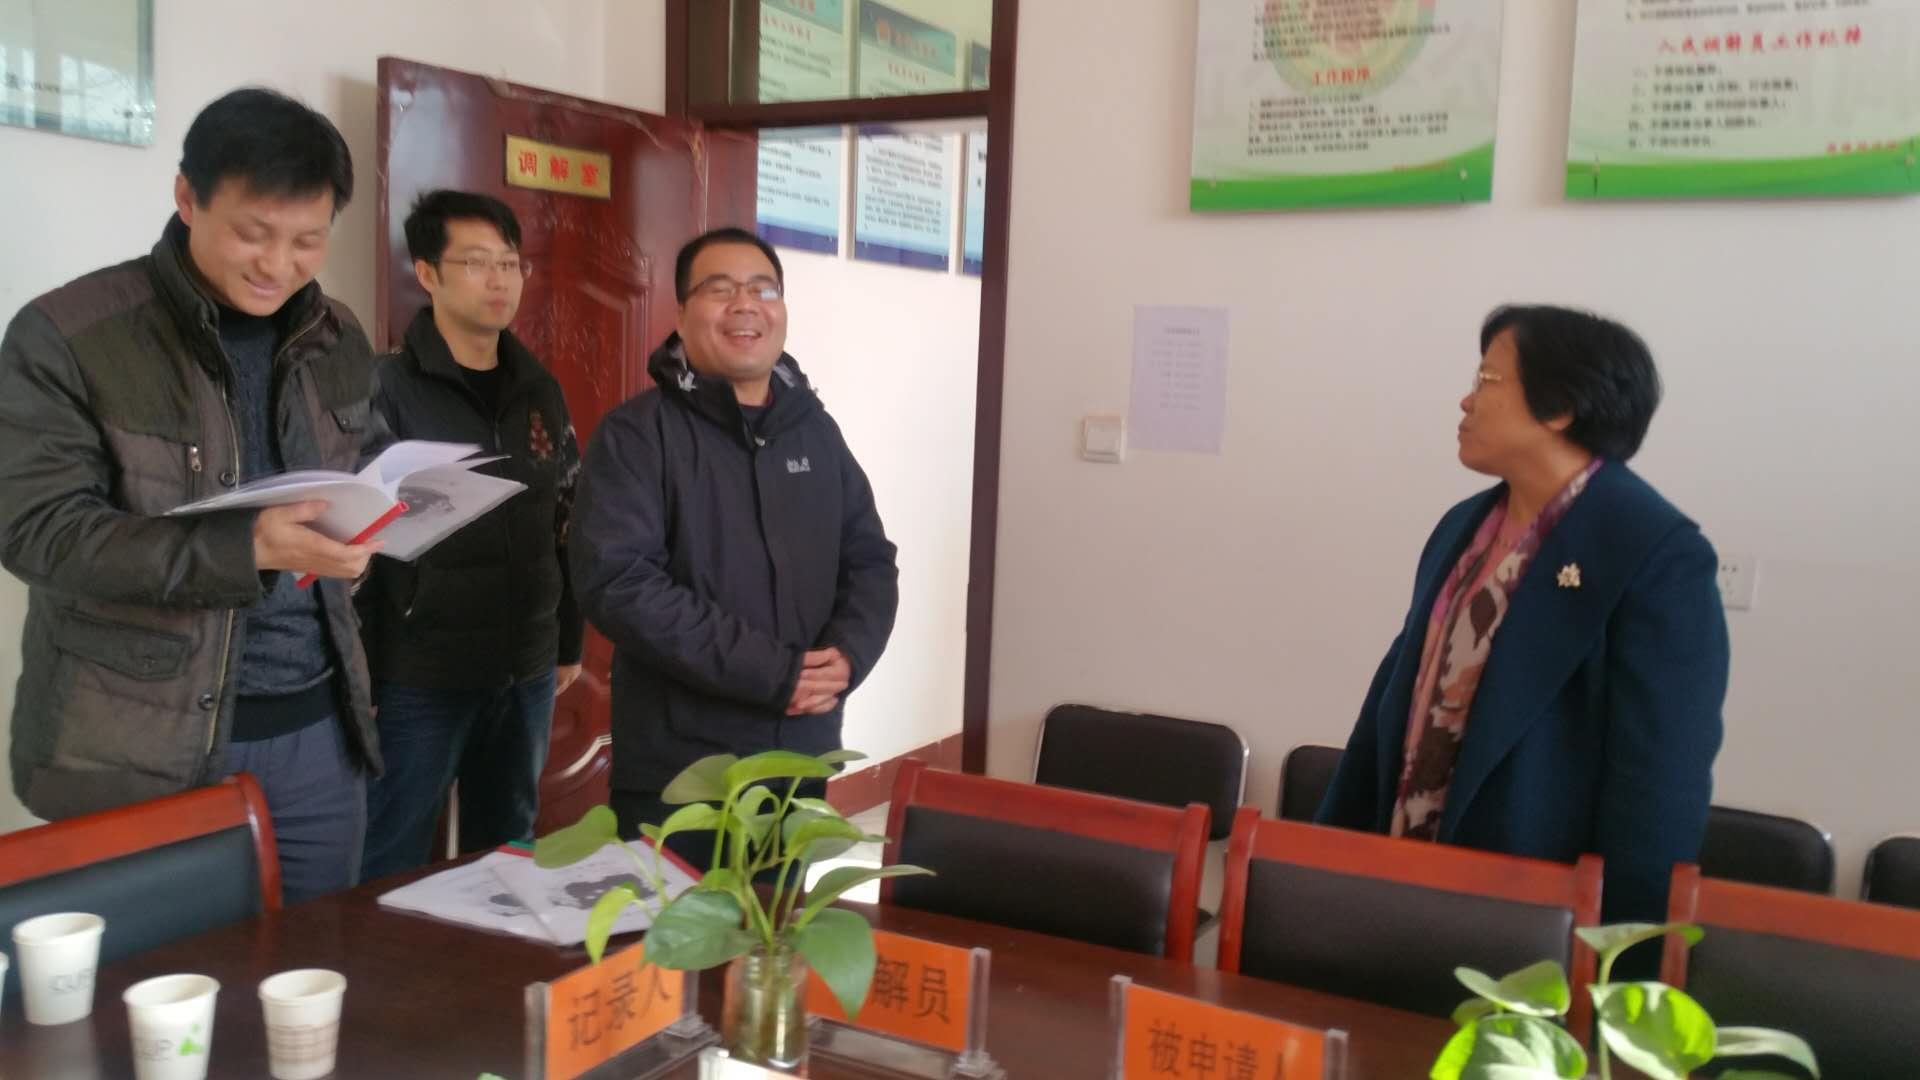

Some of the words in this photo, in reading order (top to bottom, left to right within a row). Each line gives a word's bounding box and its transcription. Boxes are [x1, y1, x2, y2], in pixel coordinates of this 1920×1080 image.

[518, 150, 598, 188] 调解室
[567, 963, 672, 1051] 记录人
[872, 953, 951, 1025] 解员
